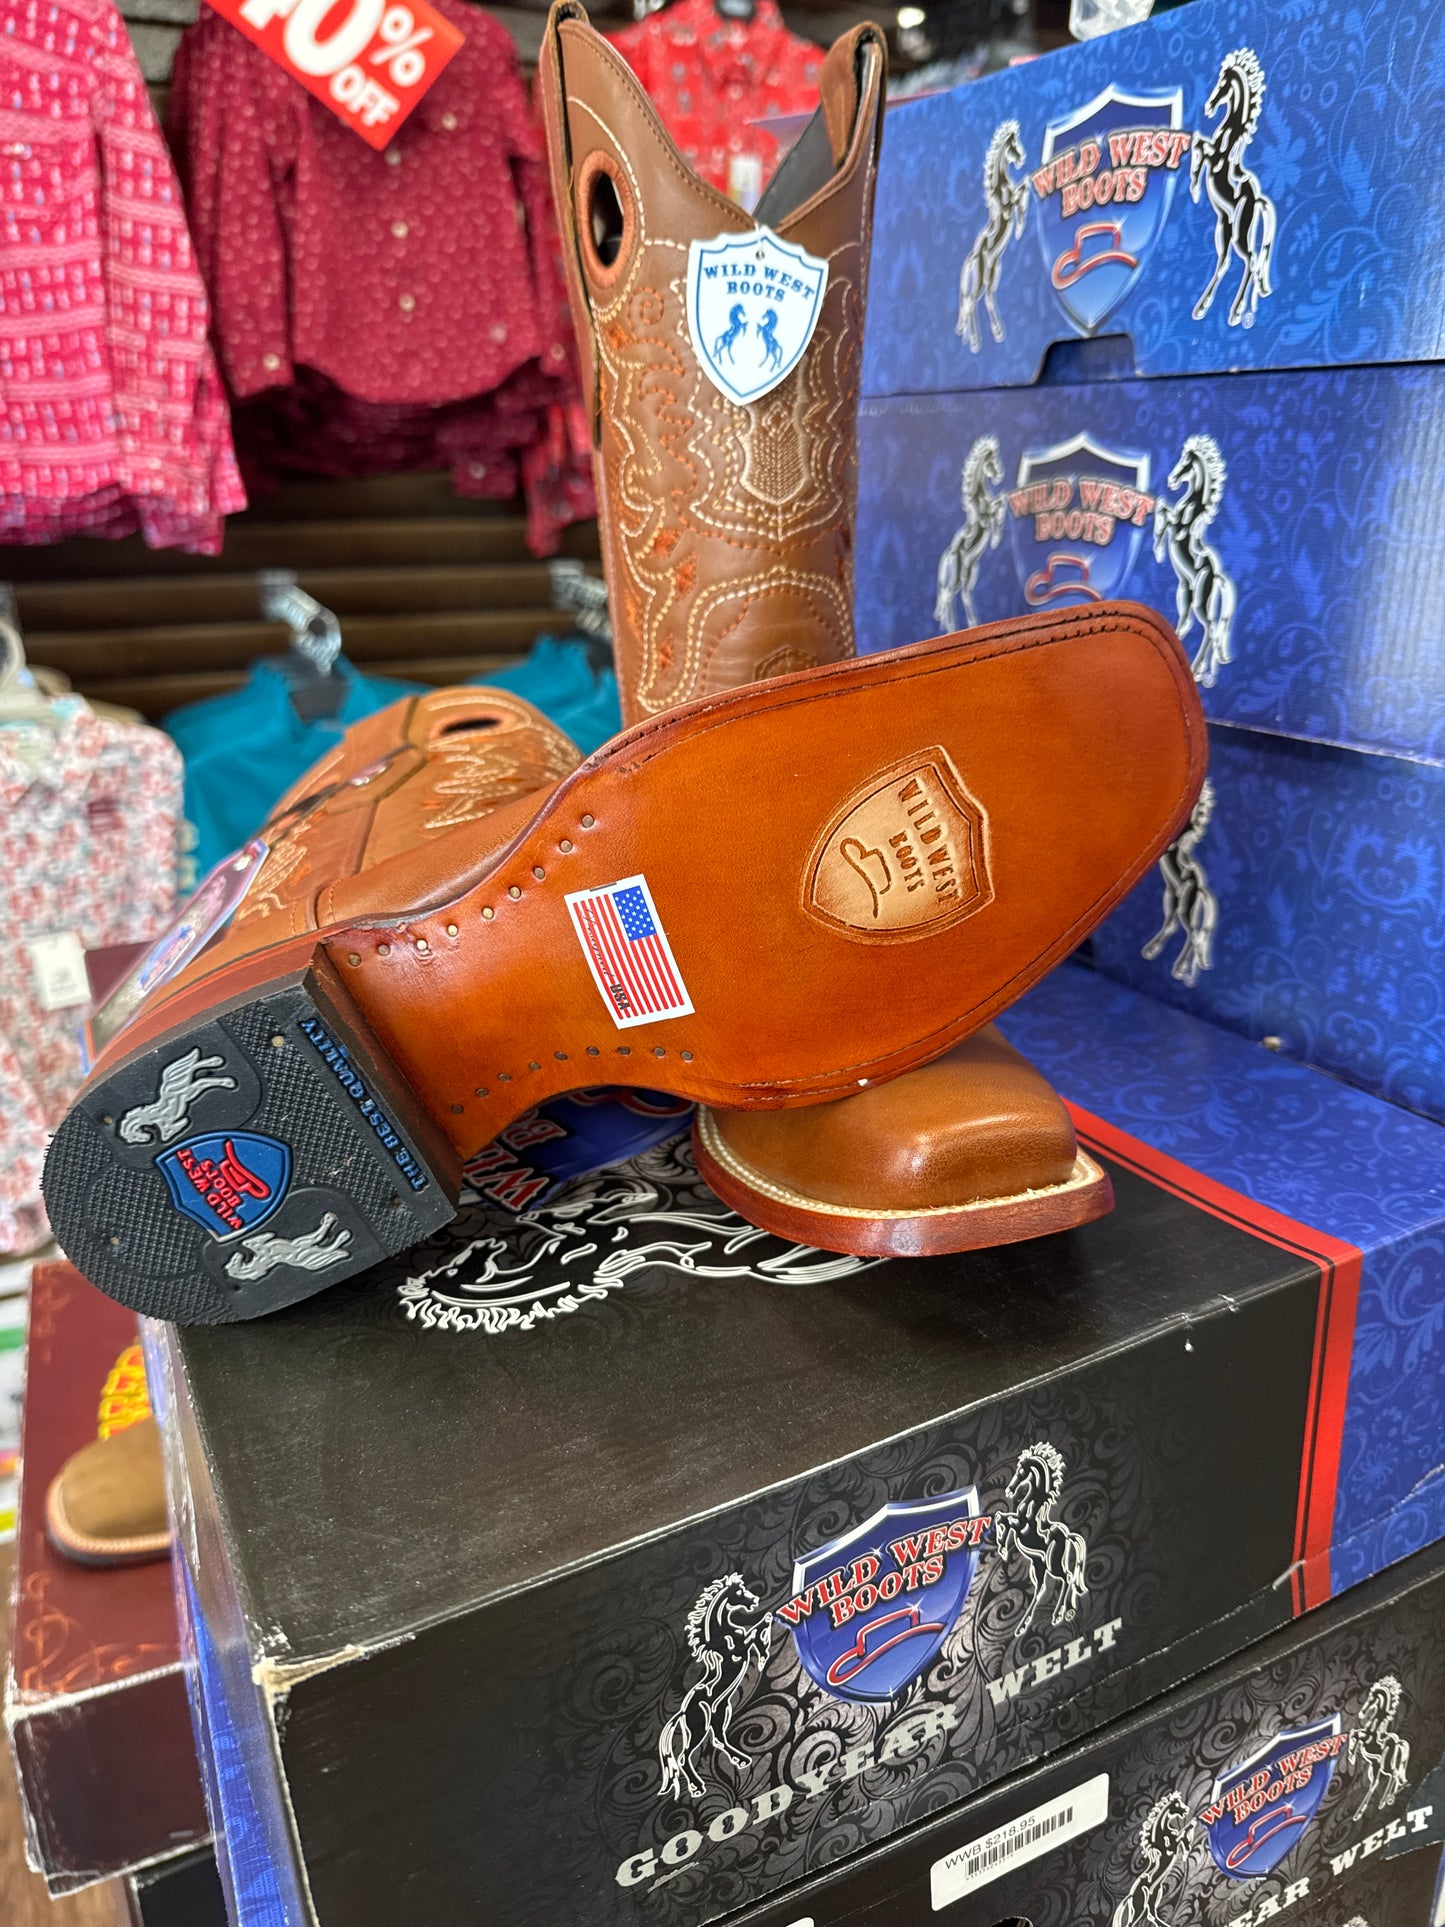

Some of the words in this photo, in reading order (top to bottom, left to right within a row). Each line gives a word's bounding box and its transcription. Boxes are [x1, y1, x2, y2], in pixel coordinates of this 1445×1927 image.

[329, 63, 400, 127] OFF
[1032, 142, 1100, 197] WILD
[1108, 131, 1191, 169] WEST
[1061, 167, 1148, 218] BOOTS
[703, 263, 756, 280] WILD
[763, 266, 815, 300] WEST
[726, 281, 786, 302] BOOTS
[1007, 479, 1072, 518] WILD
[1079, 477, 1155, 526] WEST
[1035, 510, 1115, 545] BOOTS
[888, 830, 926, 893] BOOTS
[897, 778, 943, 845] WILD
[927, 843, 962, 904] WEST
[609, 982, 631, 1011] USA
[300, 1018, 365, 1099] QUALITY
[360, 1098, 400, 1150] BEST
[176, 1148, 211, 1194] WEST
[200, 1159, 242, 1208] BOOTS
[395, 1147, 428, 1190] THE
[206, 1192, 243, 1230] WILD
[775, 1555, 880, 1625] WILD
[889, 1516, 992, 1569] WEST
[830, 1554, 944, 1628] BOOTS
[614, 1702, 960, 1888] GOODYEAR
[985, 1616, 1124, 1706] WELT
[1199, 1769, 1271, 1826] WILD
[1276, 1733, 1349, 1776] WEST
[1232, 1764, 1314, 1825] BOOTS
[945, 1844, 982, 1869] WWB
[985, 1815, 1036, 1850] $218.95
[1329, 1805, 1434, 1877] WELT
